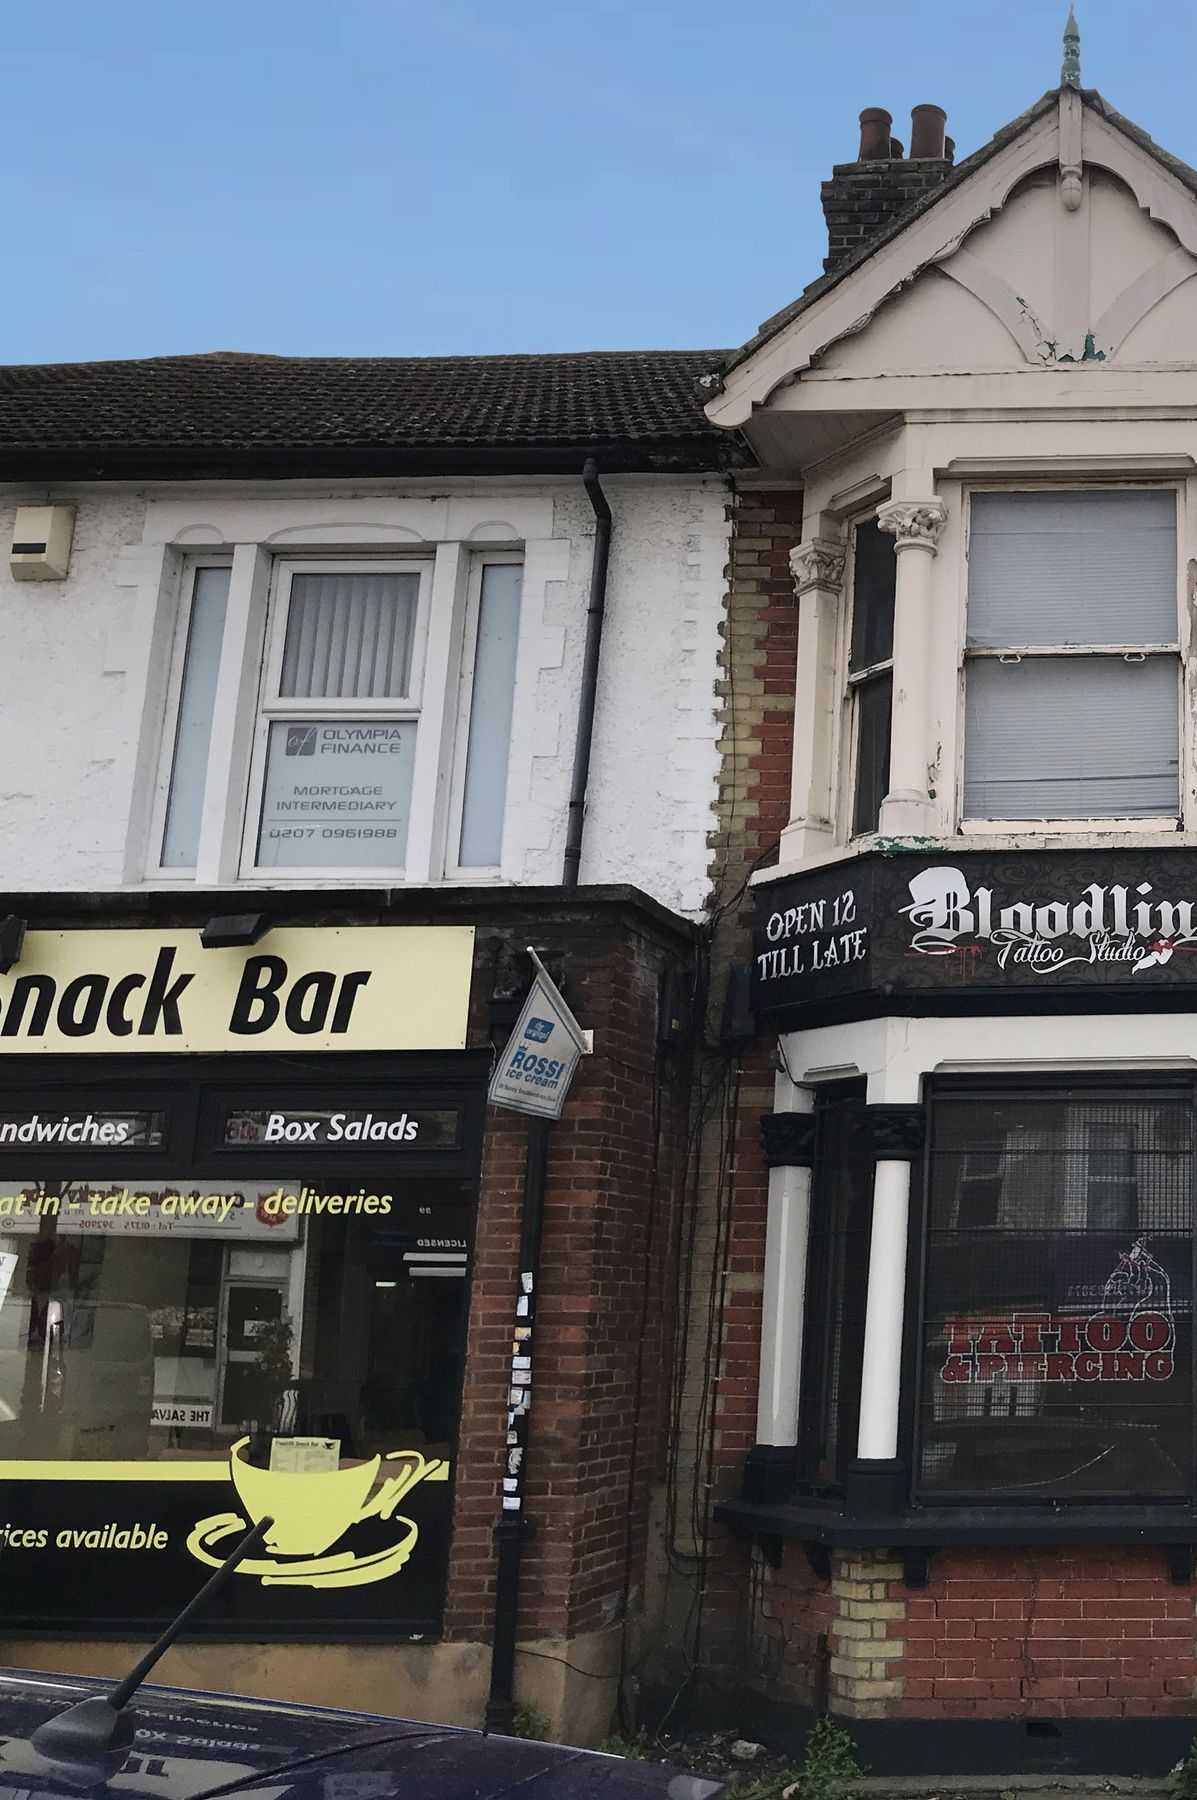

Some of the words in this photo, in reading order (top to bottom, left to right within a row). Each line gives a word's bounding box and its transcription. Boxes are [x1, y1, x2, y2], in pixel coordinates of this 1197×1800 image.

[323, 729, 401, 740] OLYMPIA
[321, 743, 401, 754] FINANCE
[293, 786, 383, 796] MORTGAGE
[276, 801, 398, 811] INTERMEDIARY
[269, 828, 316, 839] 0207
[321, 828, 397, 839] 0961988
[766, 899, 827, 941] OPEN
[832, 890, 857, 927] 12
[758, 941, 804, 981] TILL
[812, 927, 868, 971] LATE
[990, 928, 1064, 974] Tattoo
[1088, 929, 1145, 965] Studio
[0, 946, 195, 1037] nack
[229, 955, 372, 1034] Bar
[506, 1068, 523, 1080] ice
[524, 1073, 559, 1089] cream
[510, 1051, 566, 1079] ROSSI
[0, 1115, 128, 1142] ndwiches
[264, 1114, 320, 1141] Box
[327, 1114, 419, 1141] Salads
[33, 1190, 60, 1216] in
[89, 1189, 152, 1215] take
[160, 1196, 236, 1222] away
[263, 1187, 393, 1215] deliveries
[946, 1312, 1173, 1353] TATTOO
[941, 1357, 969, 1383] &
[976, 1353, 1174, 1382] PIERCING
[56, 1523, 169, 1549] available
